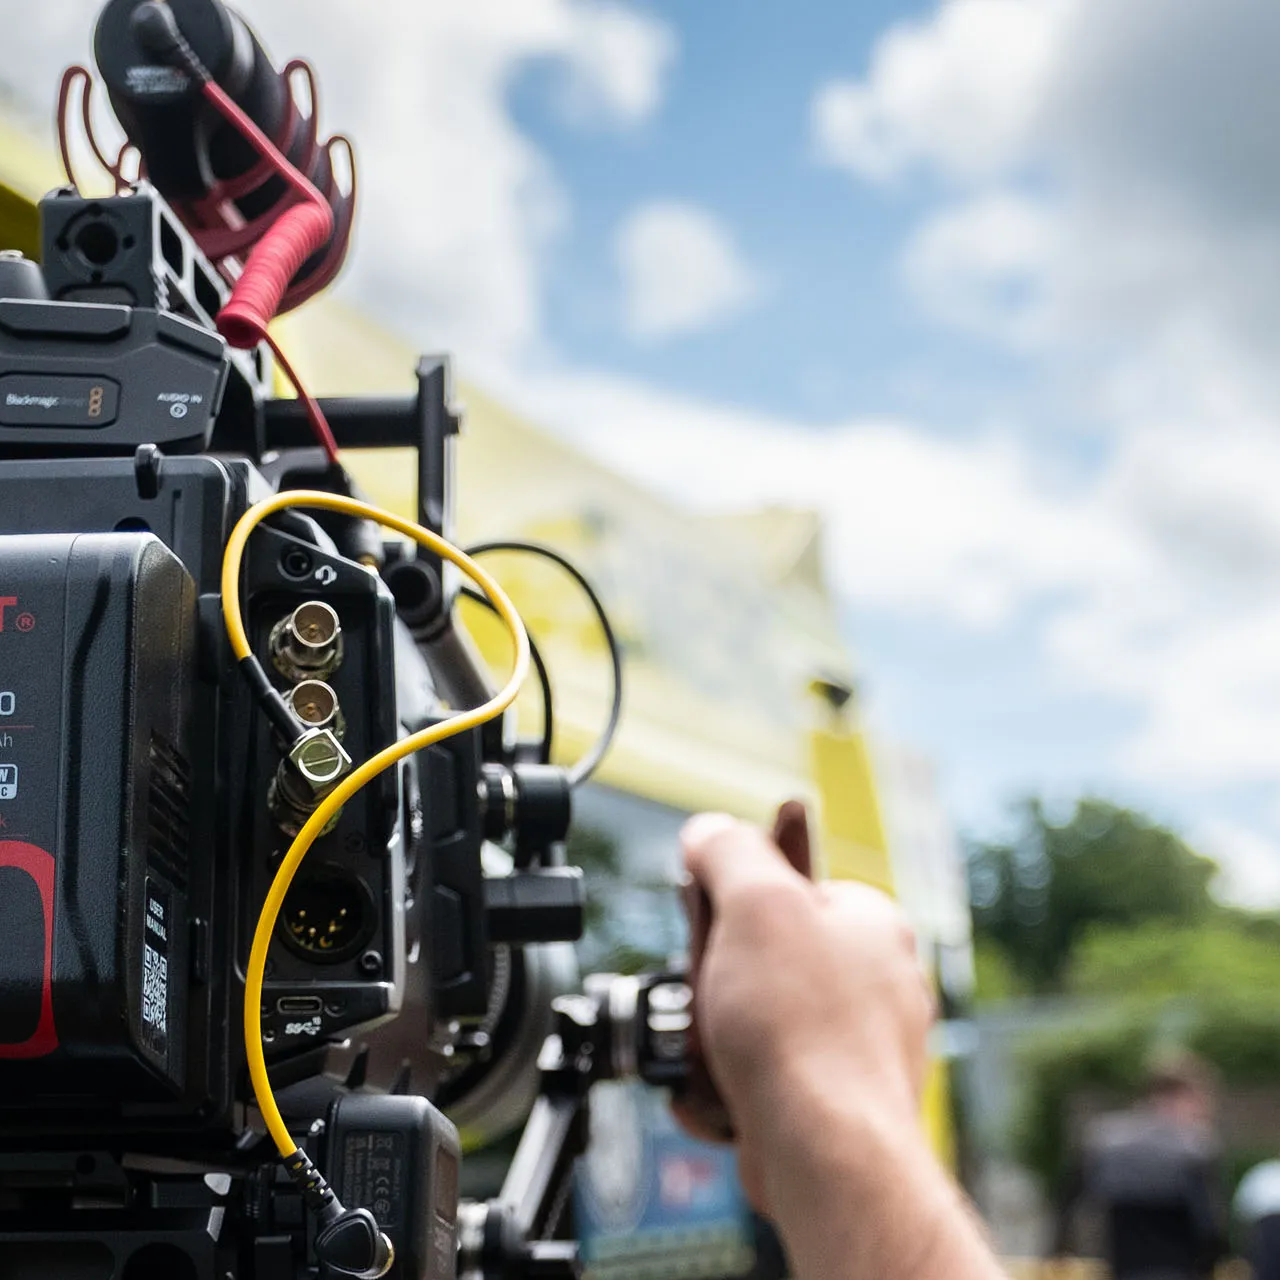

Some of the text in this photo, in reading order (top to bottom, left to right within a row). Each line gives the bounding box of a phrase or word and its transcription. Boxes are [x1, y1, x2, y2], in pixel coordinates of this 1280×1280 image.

[157, 392, 203, 404] AUDIO IN
[149, 898, 164, 921] USER
[146, 914, 168, 942] MANUAL
